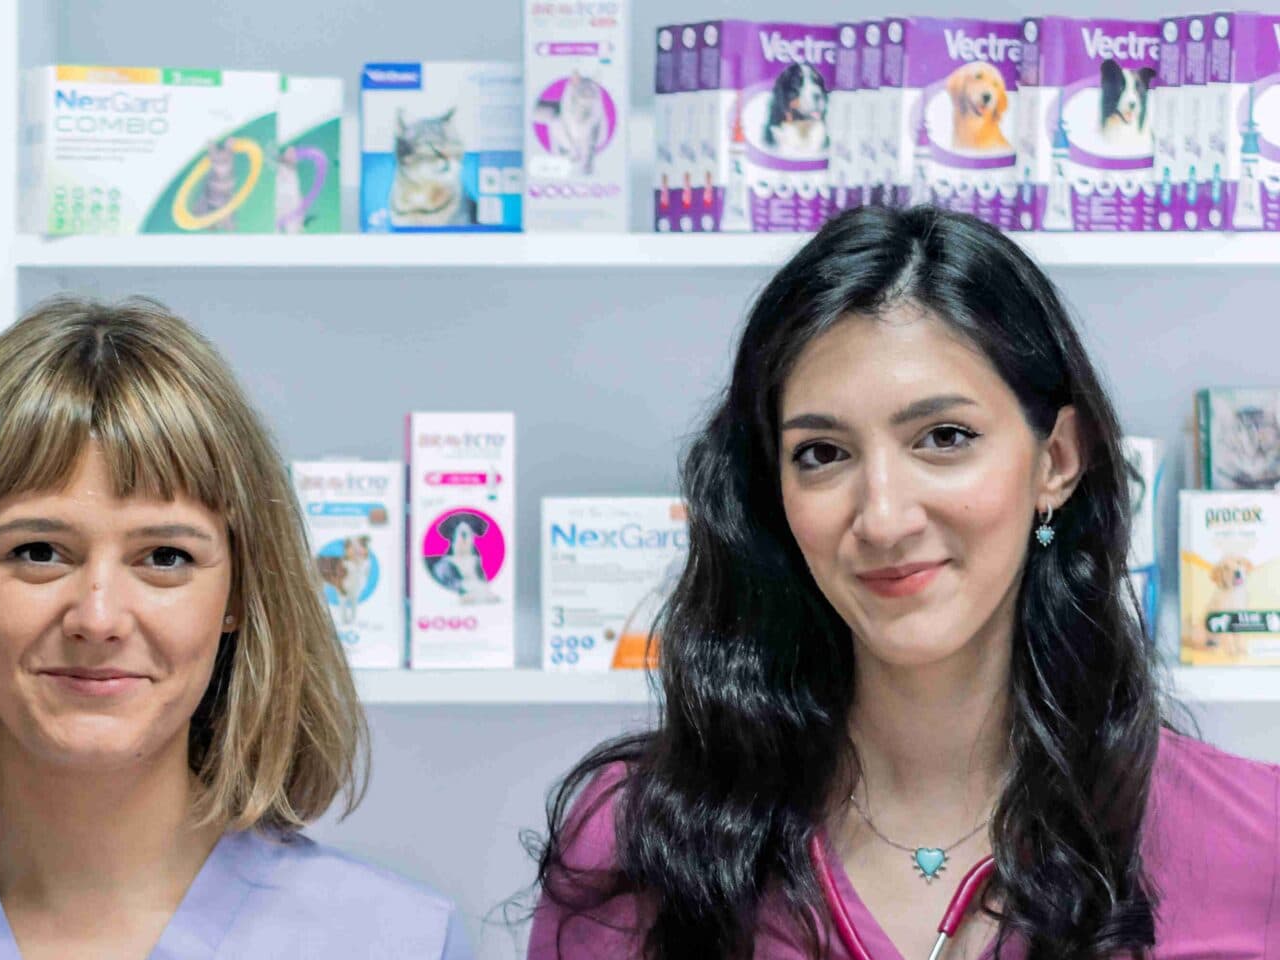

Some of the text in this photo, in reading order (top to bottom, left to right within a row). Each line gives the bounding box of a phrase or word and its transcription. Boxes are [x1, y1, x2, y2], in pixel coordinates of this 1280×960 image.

[943, 29, 1022, 63] Vectra
[54, 89, 170, 113] NexGard
[55, 115, 169, 135] COMBO
